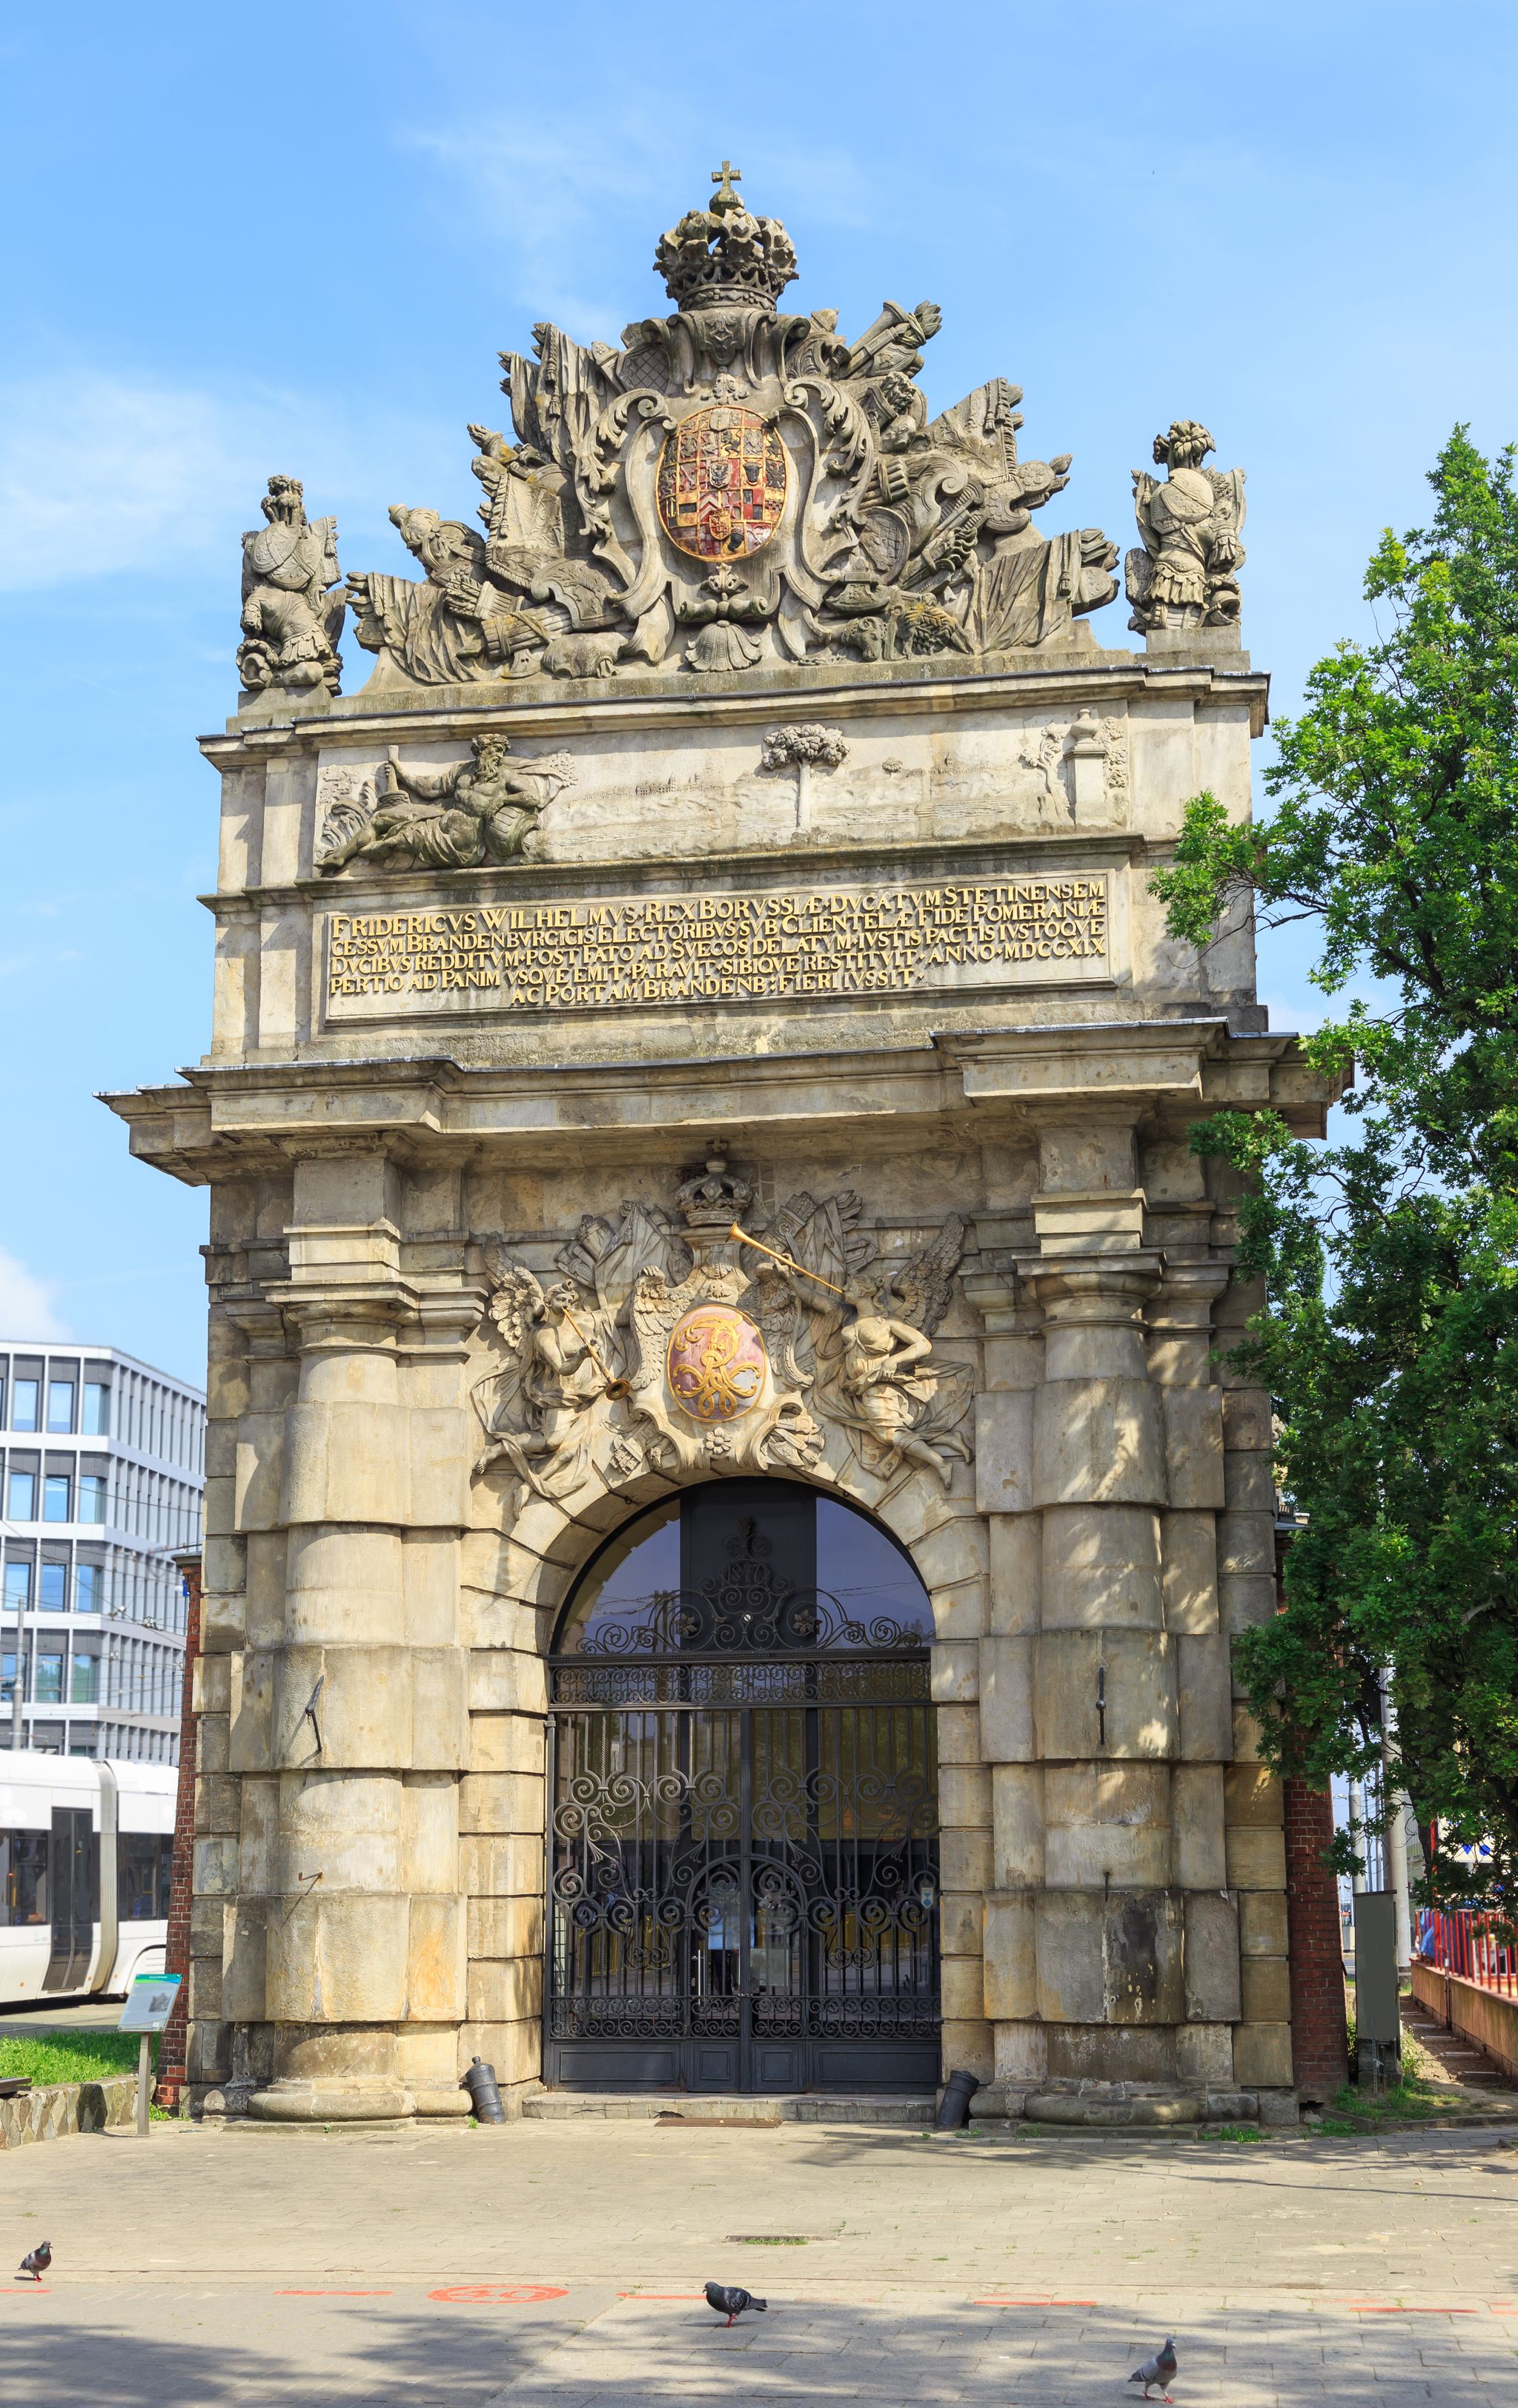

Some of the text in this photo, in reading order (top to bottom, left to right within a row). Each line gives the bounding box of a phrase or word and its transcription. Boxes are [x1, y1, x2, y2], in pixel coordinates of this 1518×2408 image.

[331, 938, 403, 956] CESSVM
[598, 921, 736, 944] ELECTORIBVS
[740, 919, 778, 936] SVB
[918, 907, 969, 926] FIDE
[332, 913, 476, 938] FRIDERICVS
[945, 881, 1104, 904] STETINENSEM
[331, 956, 411, 975] DVCIBVS
[583, 945, 634, 964] FATO
[639, 943, 669, 960] AD
[926, 924, 995, 945] PACTIS
[1000, 918, 1106, 941] IVSTOQVE
[331, 976, 404, 993] PERTIO
[408, 973, 437, 990] AD
[442, 970, 500, 989] PANIM
[507, 967, 570, 985] VSQVE
[511, 987, 540, 1005] AC
[545, 982, 639, 1002] PORTAM
[778, 973, 839, 992] FIERI
